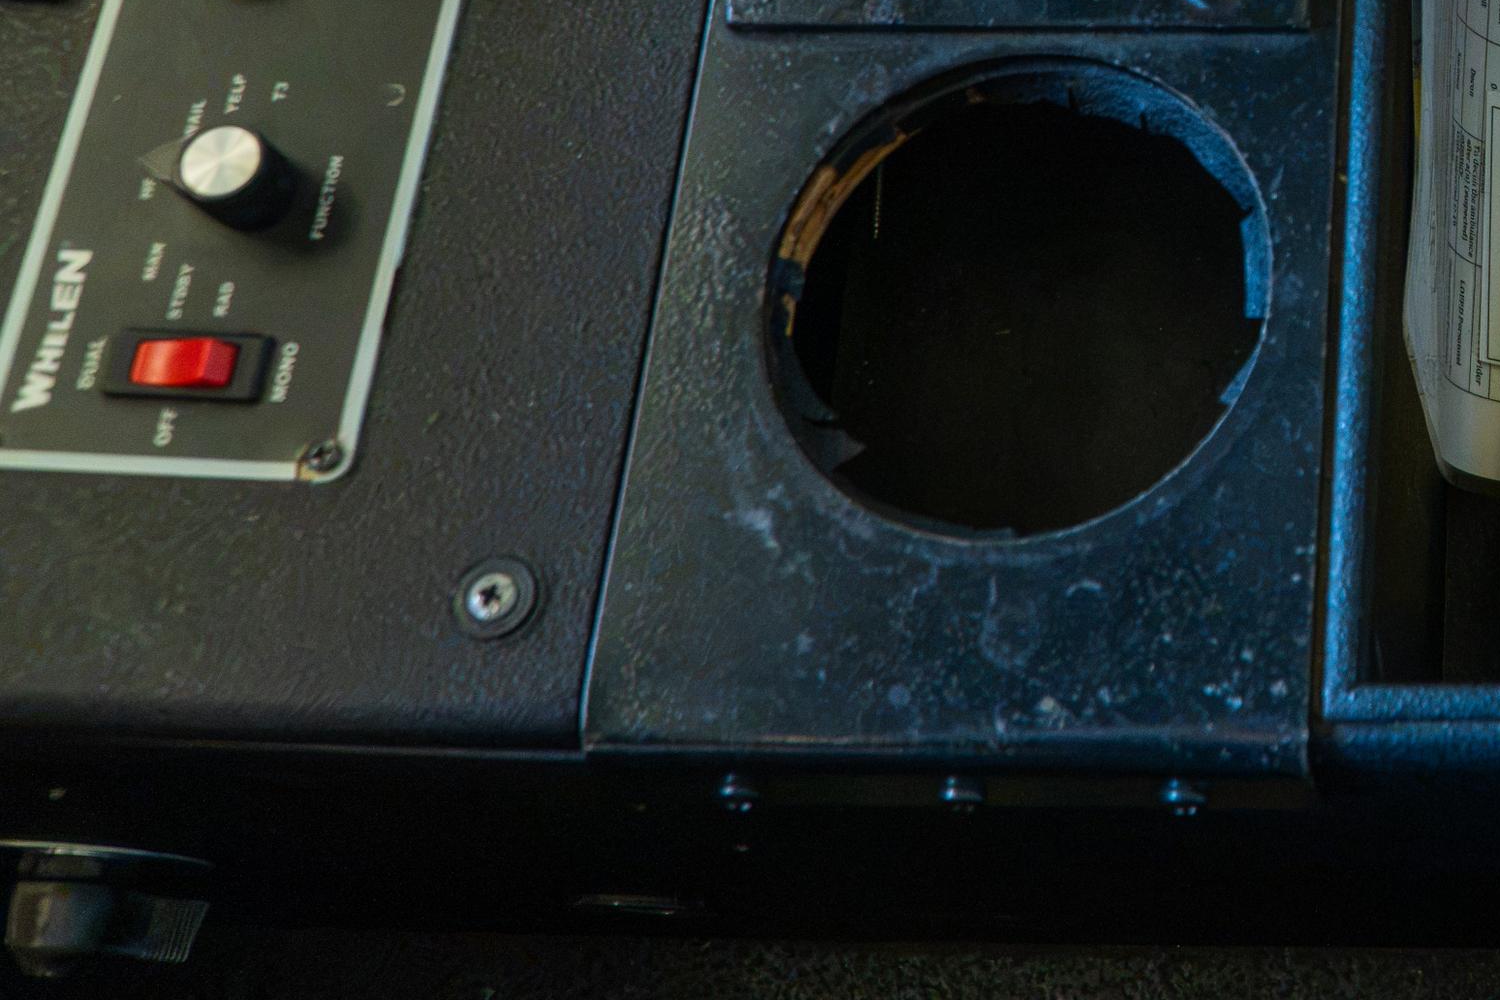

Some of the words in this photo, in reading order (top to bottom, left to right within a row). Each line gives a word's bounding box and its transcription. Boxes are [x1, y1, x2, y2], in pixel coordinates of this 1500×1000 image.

[223, 72, 247, 114] YELP
[309, 155, 344, 240] FUNCTION
[77, 337, 108, 390] DUAL
[269, 341, 300, 403] MONO
[153, 407, 178, 447] OFF
